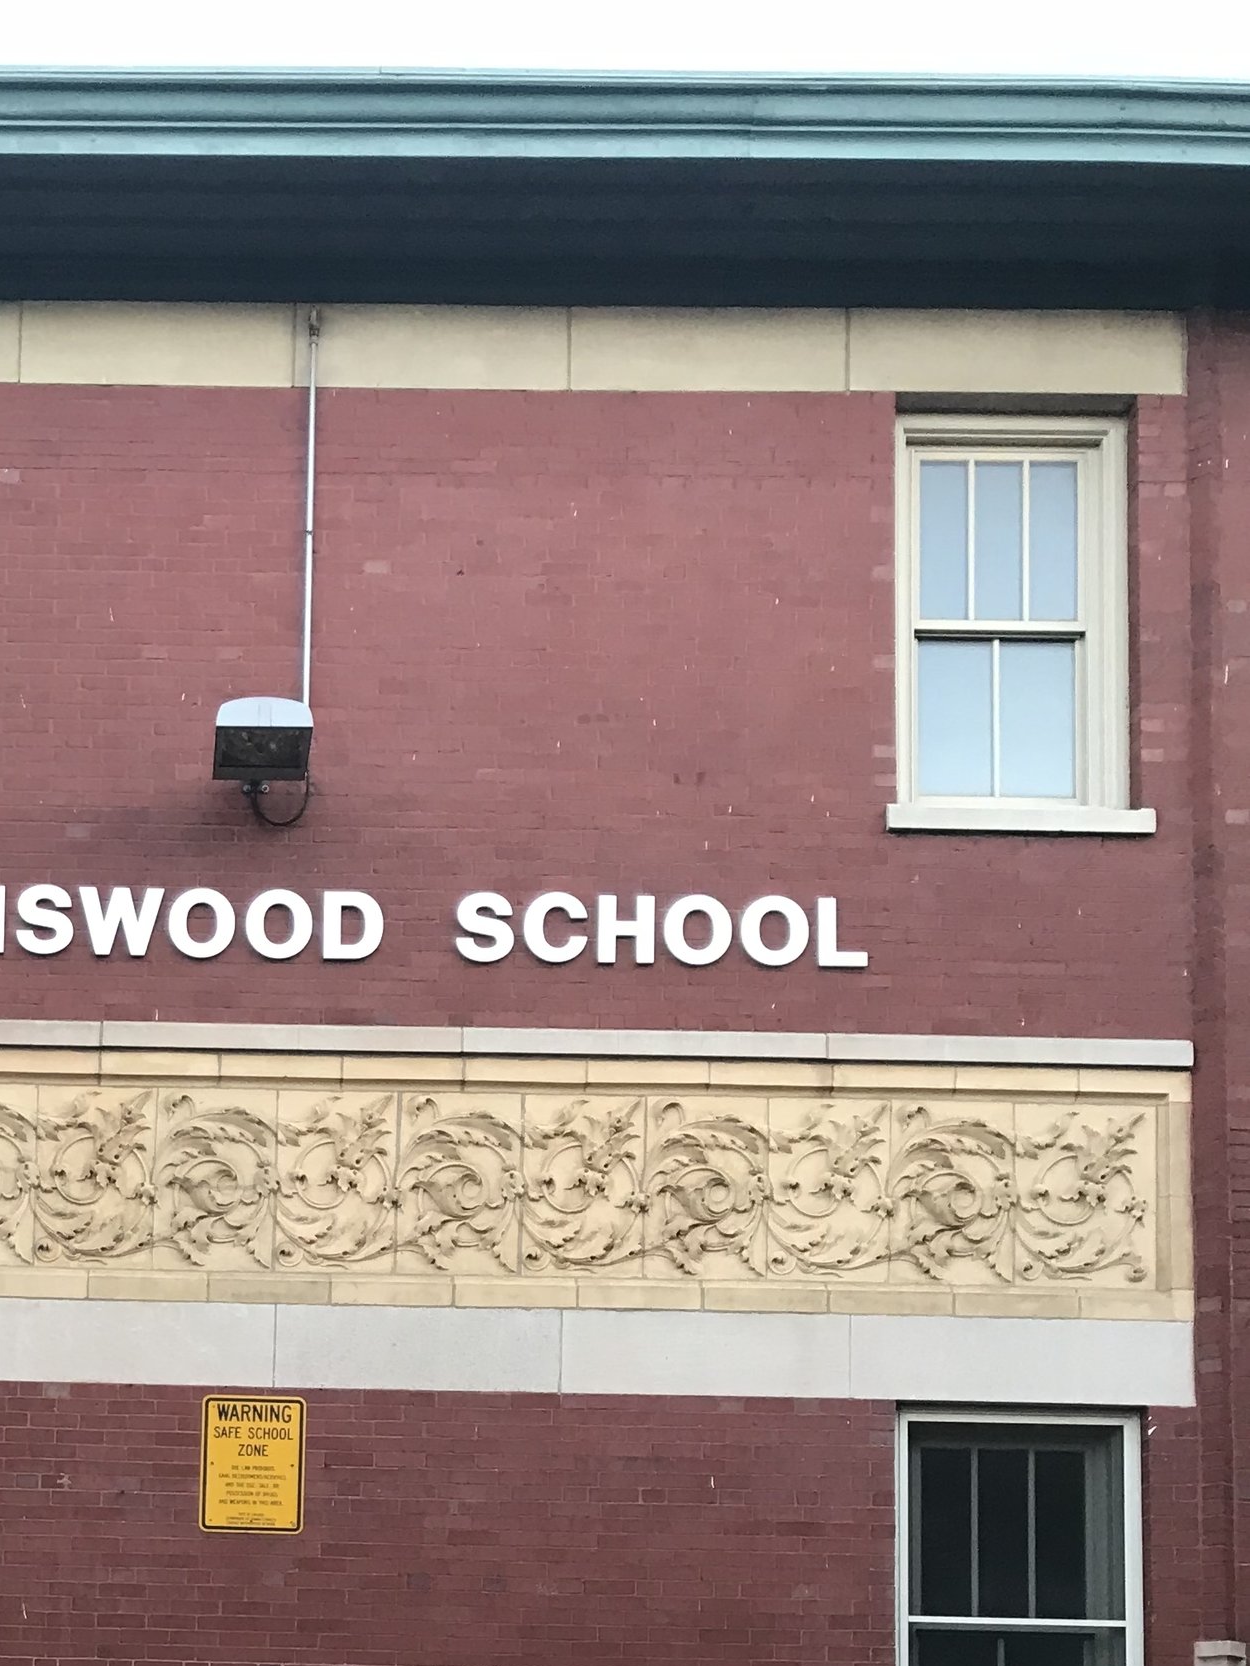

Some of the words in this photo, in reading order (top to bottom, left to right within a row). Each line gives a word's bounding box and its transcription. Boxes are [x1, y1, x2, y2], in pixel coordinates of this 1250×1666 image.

[456, 891, 869, 968] SCHOOL
[217, 1403, 292, 1423] WARNING
[213, 1426, 241, 1439] SAFE
[248, 1427, 293, 1440] SCHOOL
[238, 1444, 269, 1456] ZONE
